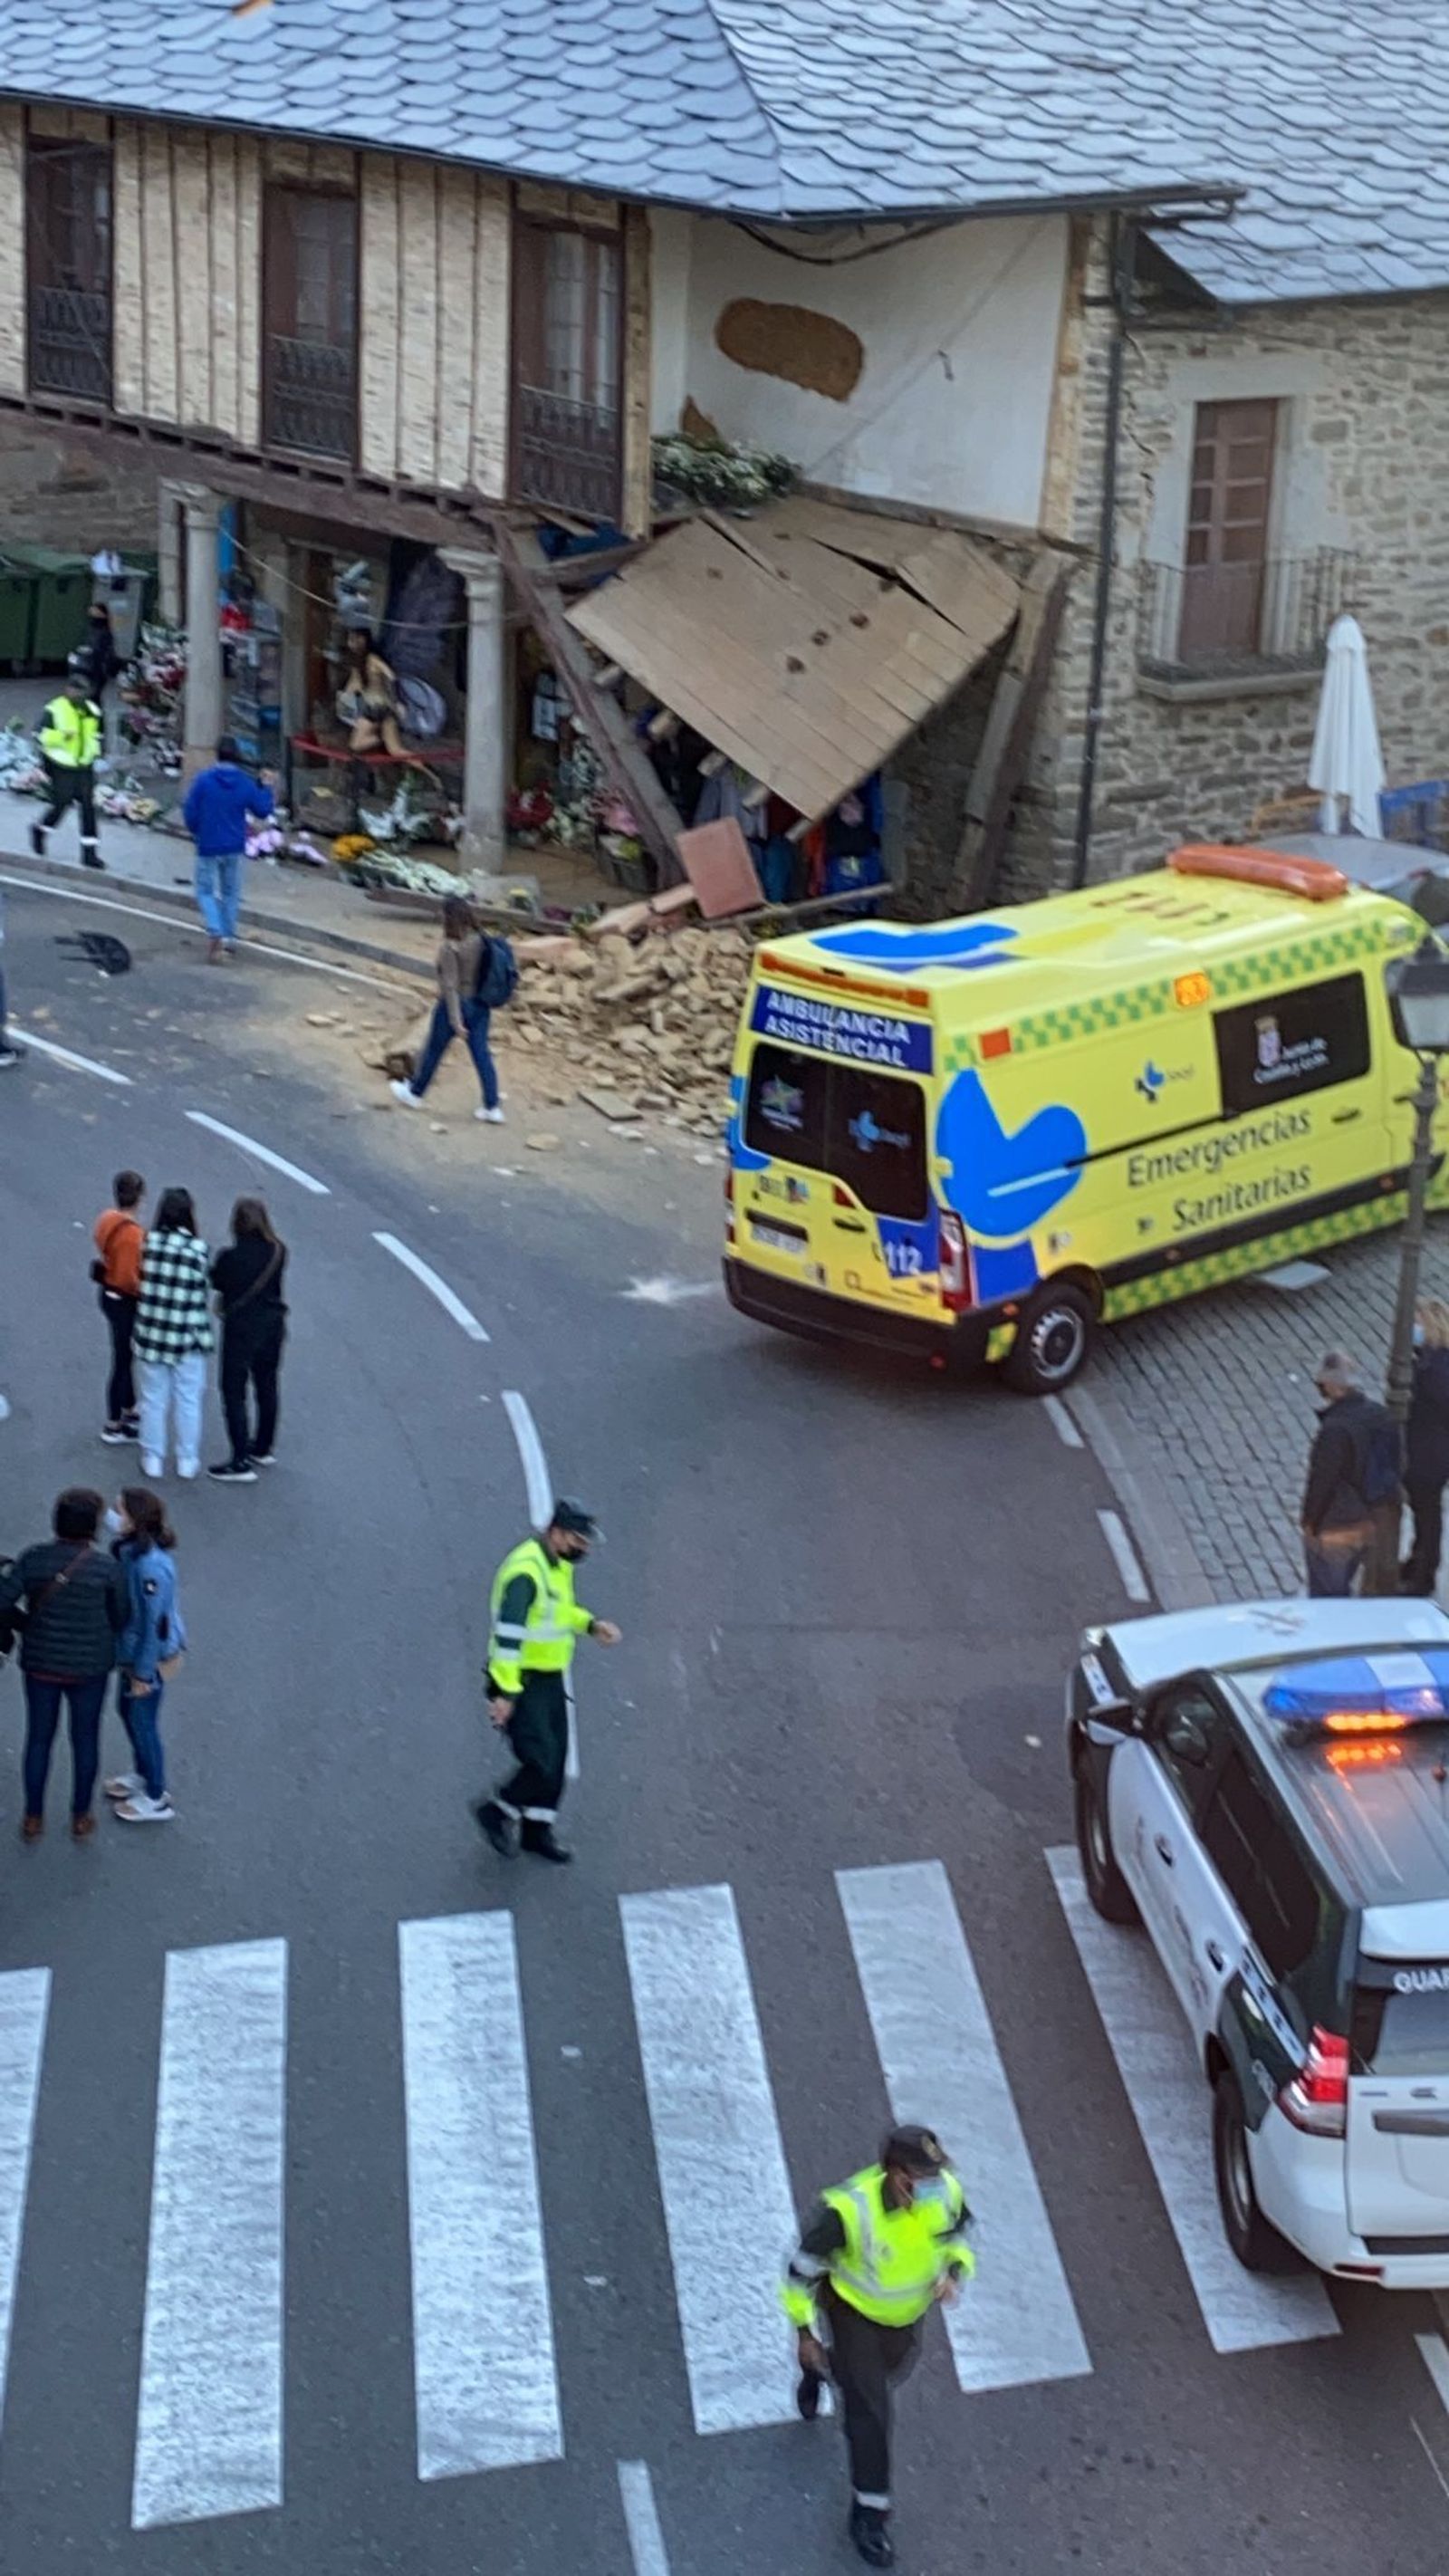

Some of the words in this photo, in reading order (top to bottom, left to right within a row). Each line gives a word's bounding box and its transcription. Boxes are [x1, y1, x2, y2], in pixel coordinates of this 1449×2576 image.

[763, 1014, 907, 1068] ASISTENCIAL
[766, 990, 912, 1045] AMBULANCIA
[1128, 1109, 1311, 1187] Emergencias
[1172, 1164, 1311, 1231] Sanitarias
[884, 1240, 924, 1276] 112
